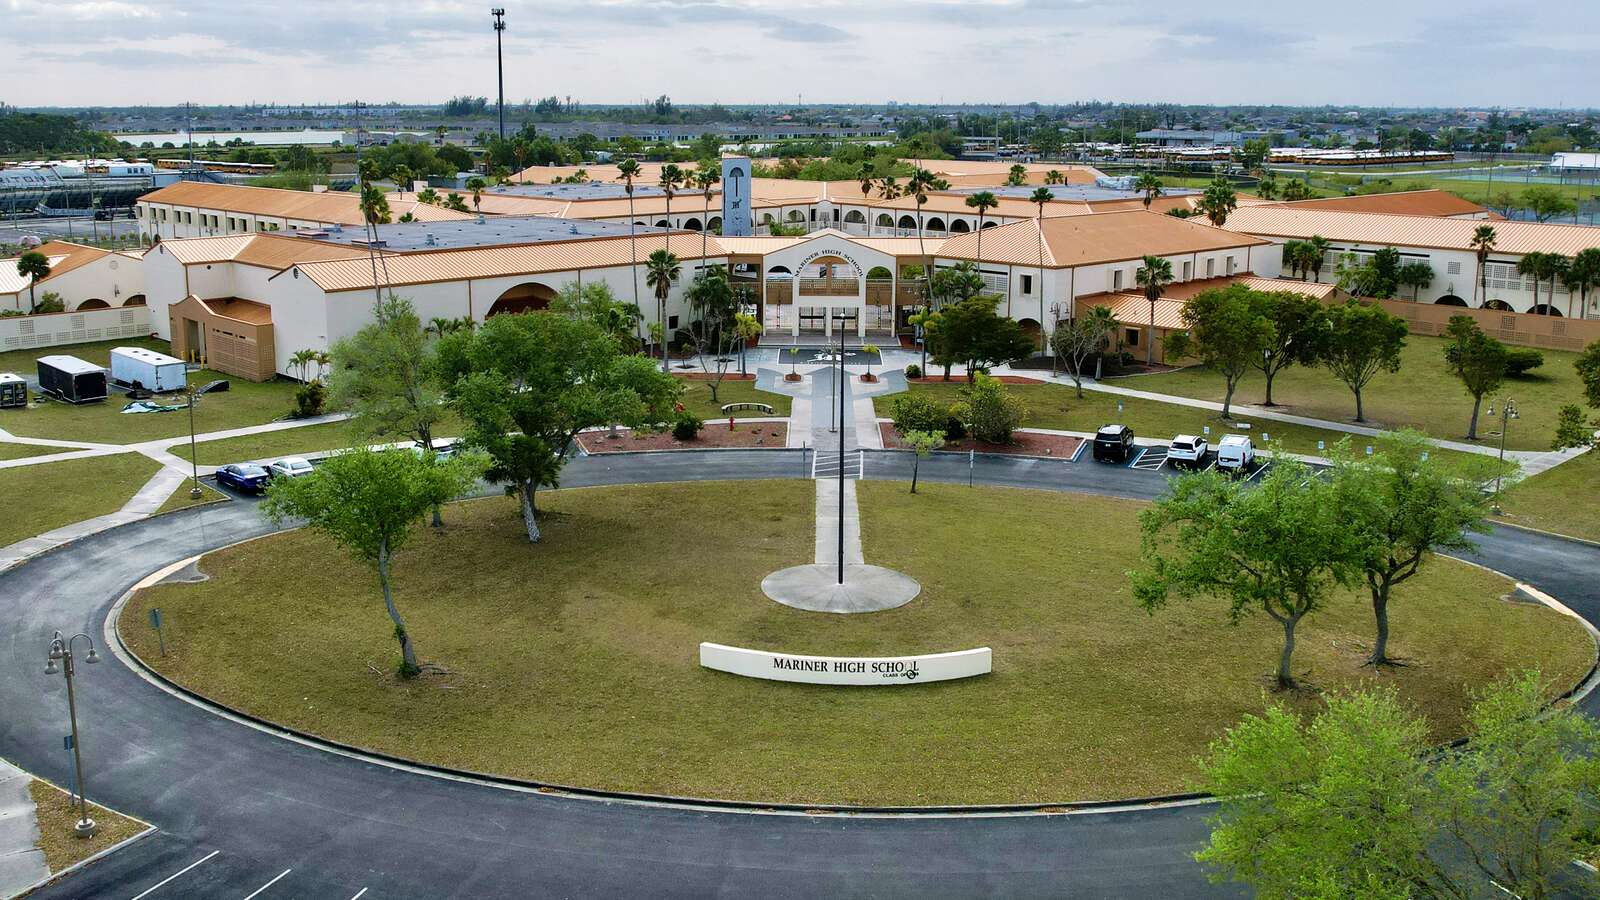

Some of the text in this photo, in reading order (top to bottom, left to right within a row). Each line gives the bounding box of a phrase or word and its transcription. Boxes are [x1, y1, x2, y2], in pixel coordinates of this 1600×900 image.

[795, 252, 819, 277] MARINER
[843, 254, 864, 277] SCHOOL
[773, 658, 828, 672] MARINER
[834, 662, 866, 673] HIGH
